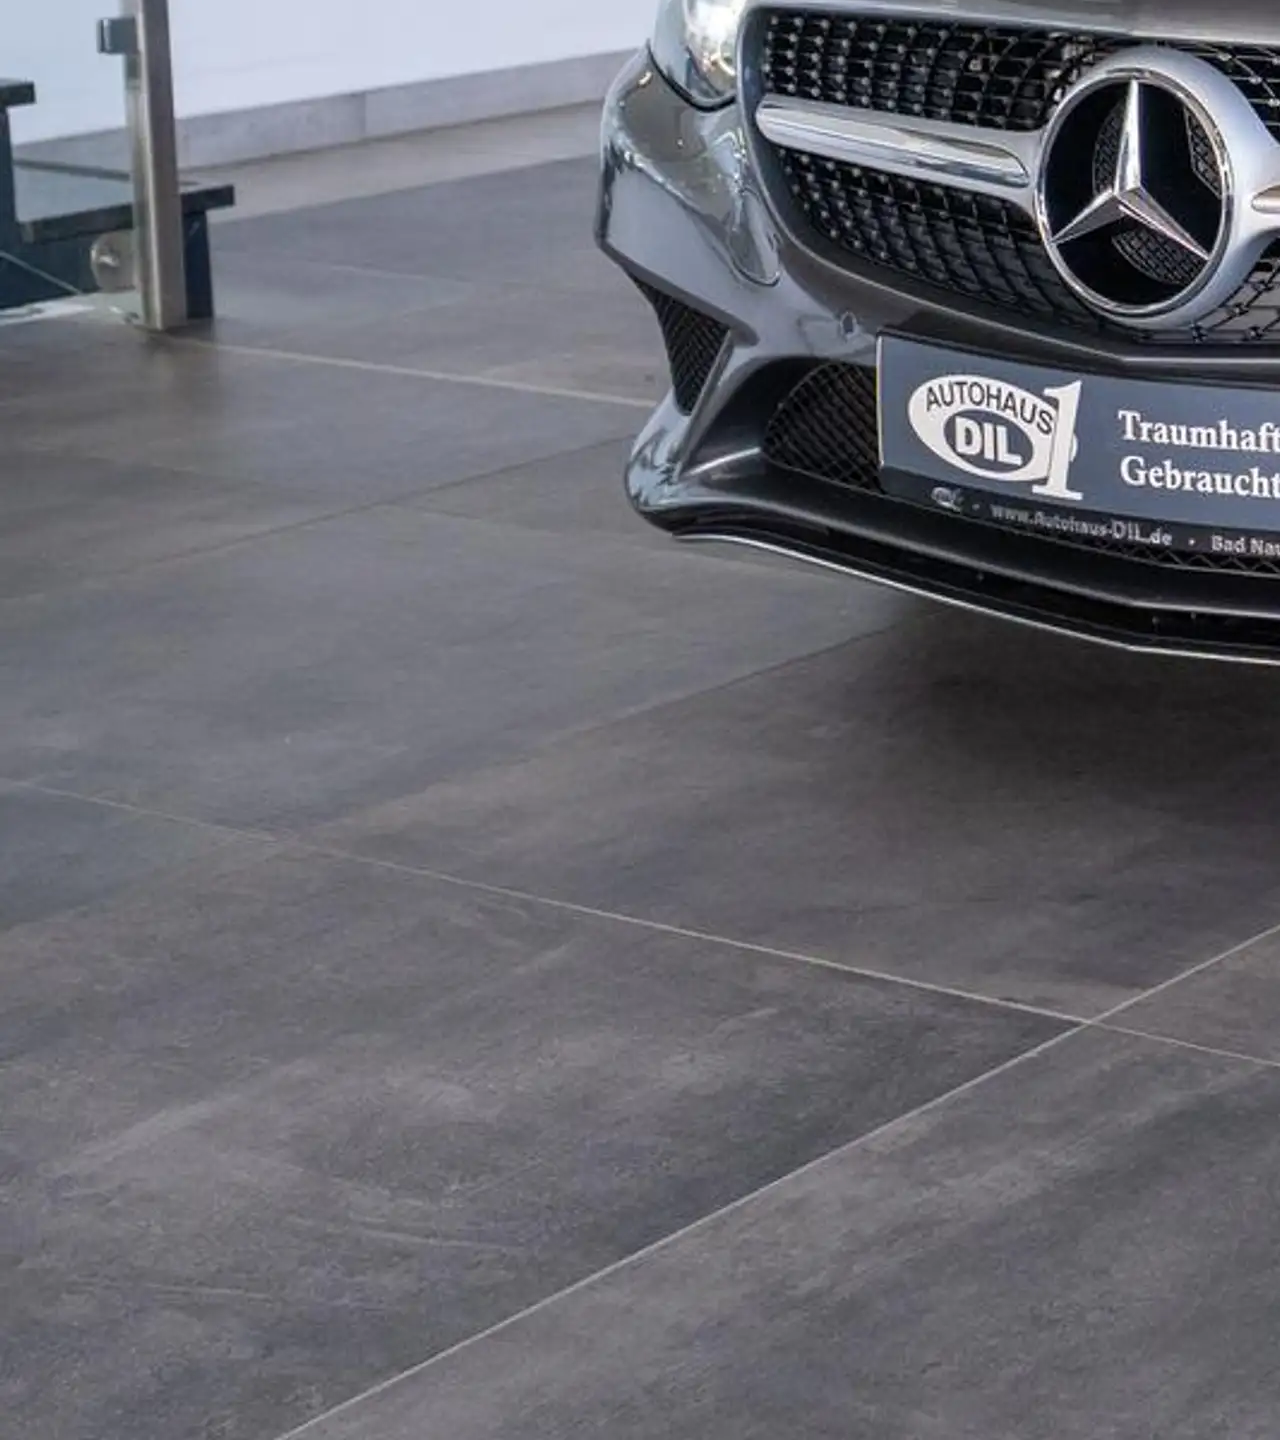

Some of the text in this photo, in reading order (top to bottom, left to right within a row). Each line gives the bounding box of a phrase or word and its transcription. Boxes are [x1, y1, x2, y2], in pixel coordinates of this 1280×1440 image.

[926, 380, 1053, 434] AUTOHAUS
[954, 415, 1023, 467] DIL
[1210, 534, 1246, 553] Bad
